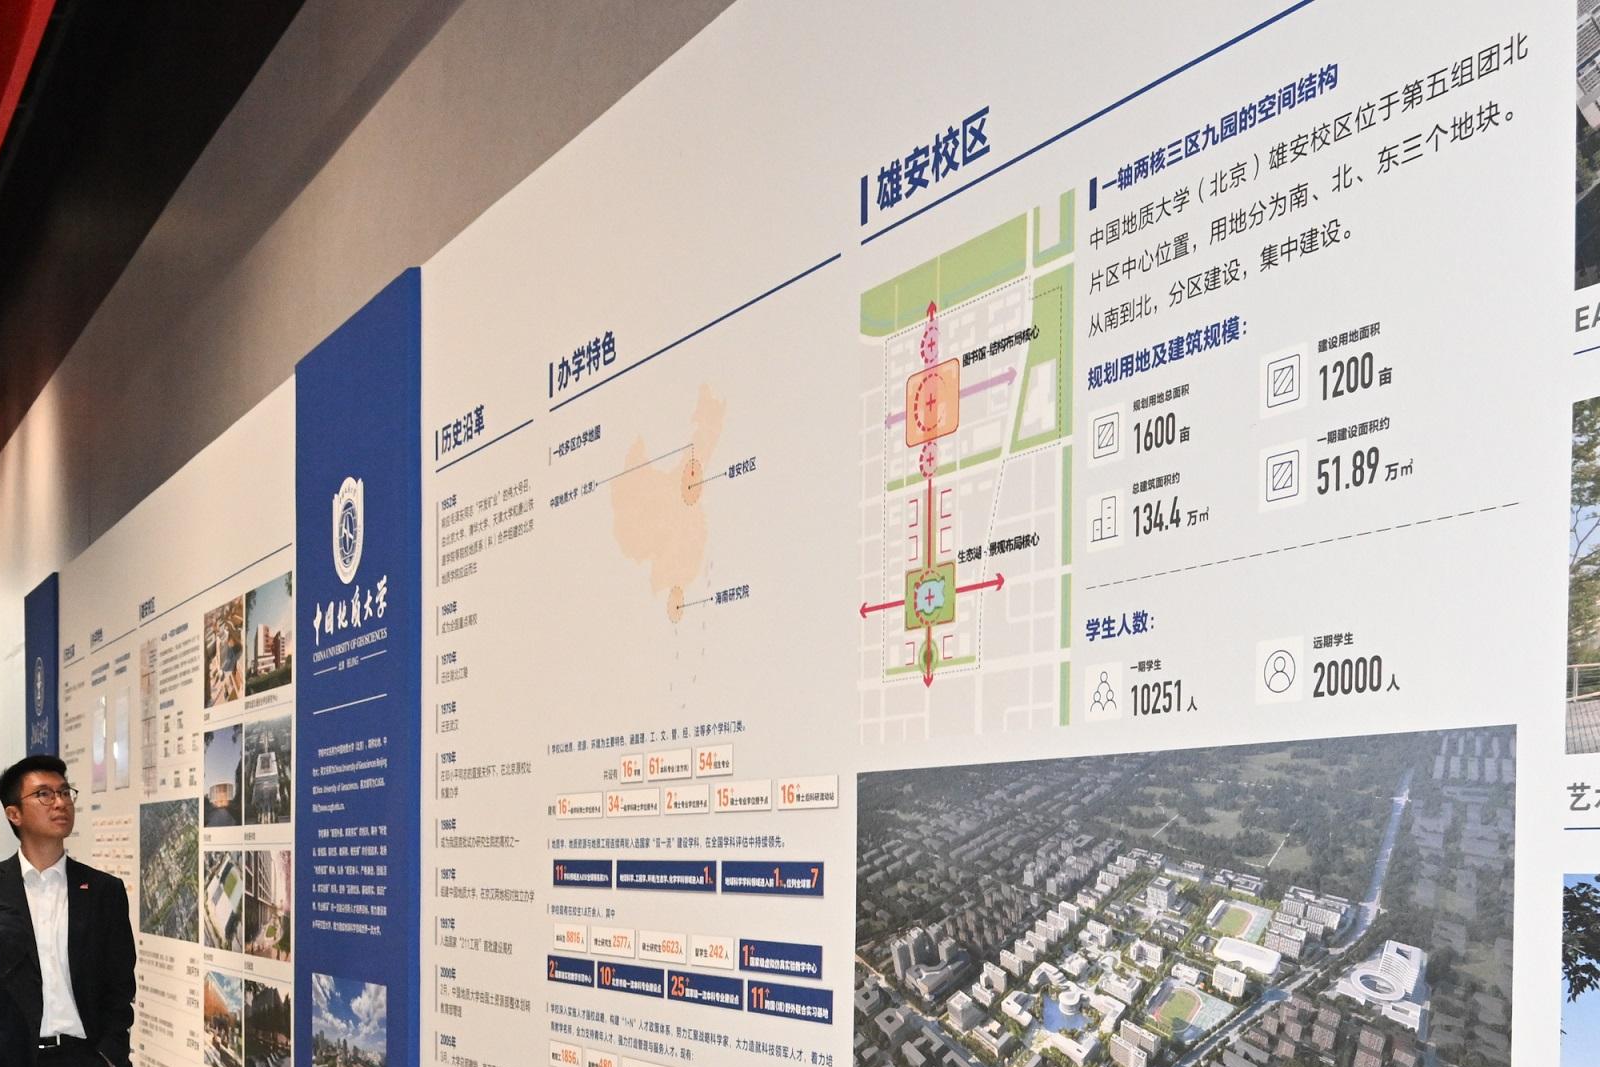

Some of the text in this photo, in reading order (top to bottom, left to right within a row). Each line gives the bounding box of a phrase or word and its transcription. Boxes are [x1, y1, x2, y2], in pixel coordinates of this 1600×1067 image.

[1089, 33, 1530, 250] 中国地质大学（北京）雄安校区位于第五组团北
[1102, 62, 1338, 193] 一轴两核三区九园的空间结构
[876, 107, 990, 210] 雄安校区
[1089, 103, 1515, 293] 片区中心位置，用地分为南、北、东三个地块。
[1089, 223, 1353, 338] 从南到北，分区建设，集中建设。
[1087, 315, 1247, 390] 规划用地及建筑规模：
[1318, 322, 1380, 354] 建设用地面积
[558, 330, 617, 391] 办学特色
[1133, 384, 1190, 412] 规划用地总面积
[441, 404, 485, 455] 历史沿革
[1317, 417, 1390, 444] 一期建设面积约
[728, 457, 756, 479] 雄安校区
[1132, 472, 1180, 495] 总建筑面积约
[1317, 447, 1379, 495] 51.89
[1133, 496, 1180, 537] 134.4
[715, 584, 750, 605] 海南研究院
[1086, 610, 1154, 642] 学生人数：
[1313, 632, 1353, 649] 远期学生
[1130, 659, 1161, 672] 一期学生
[1313, 655, 1382, 698] 20000
[1131, 680, 1181, 716] 10251
